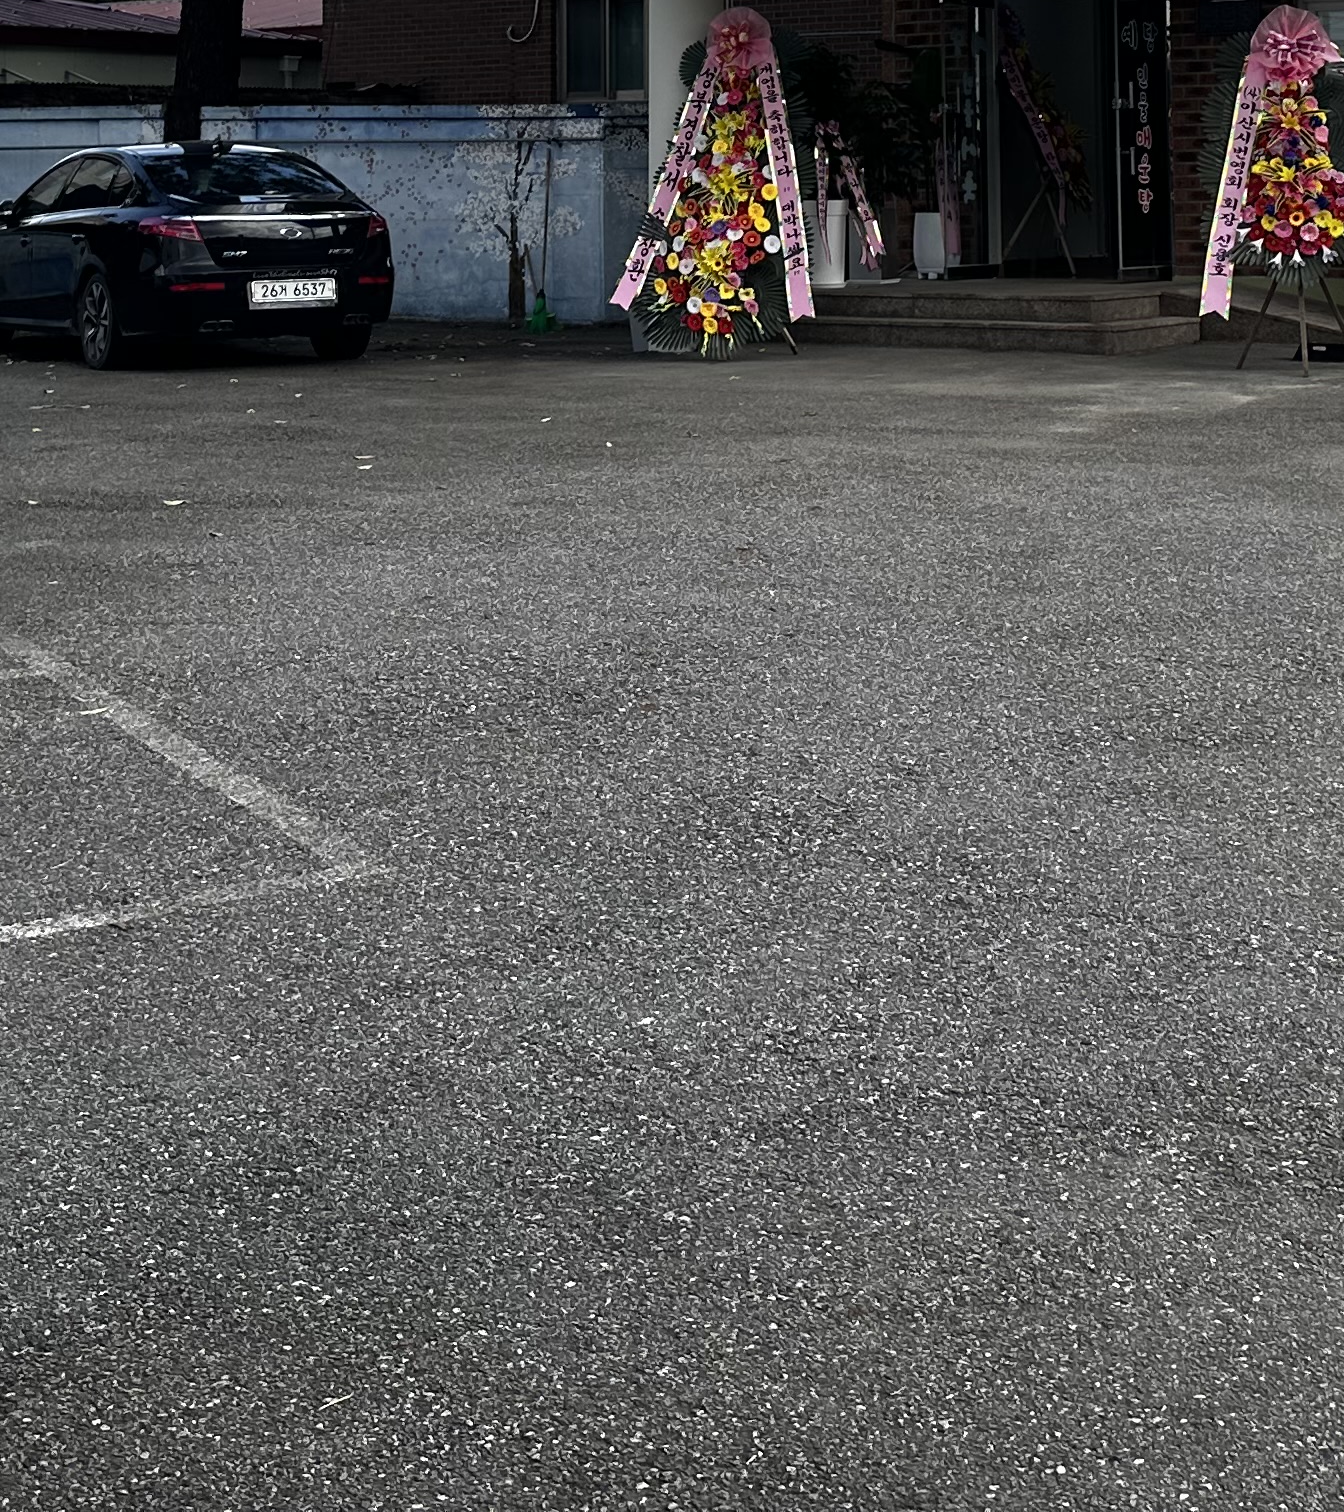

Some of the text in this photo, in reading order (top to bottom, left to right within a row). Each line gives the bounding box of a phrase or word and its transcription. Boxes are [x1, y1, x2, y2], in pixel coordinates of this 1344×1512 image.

[768, 109, 793, 177] 축하합니다
[1219, 197, 1240, 226] 회장
[293, 282, 327, 296] 6537
